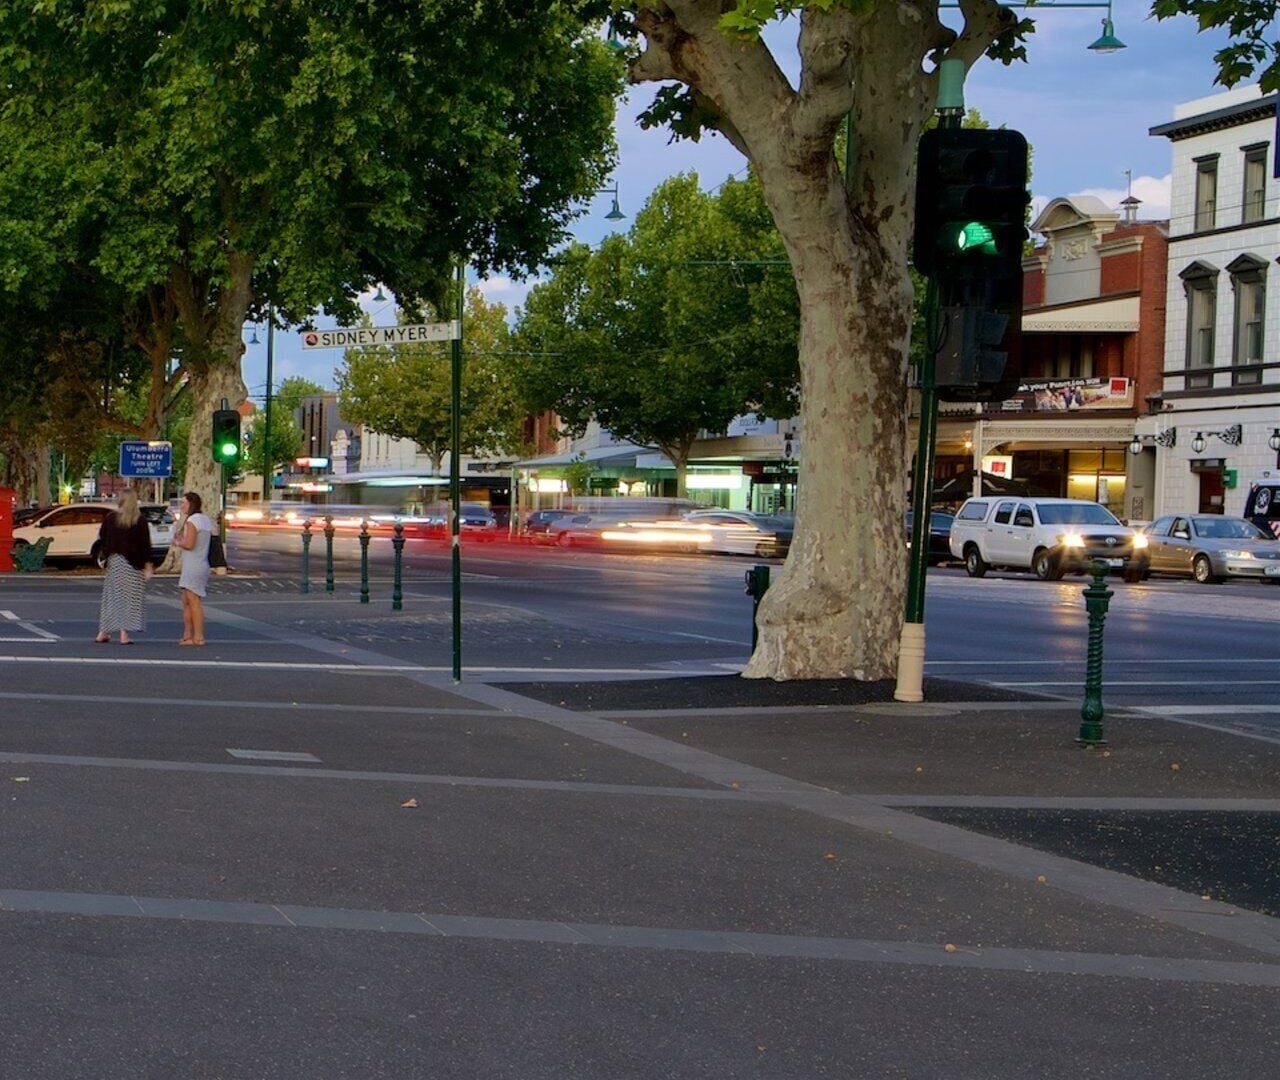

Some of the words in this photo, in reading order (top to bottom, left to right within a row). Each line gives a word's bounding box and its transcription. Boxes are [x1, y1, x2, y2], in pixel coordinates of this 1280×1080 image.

[322, 330, 378, 346] SIDNEY
[384, 327, 428, 342] MYER
[1030, 383, 1047, 392] your
